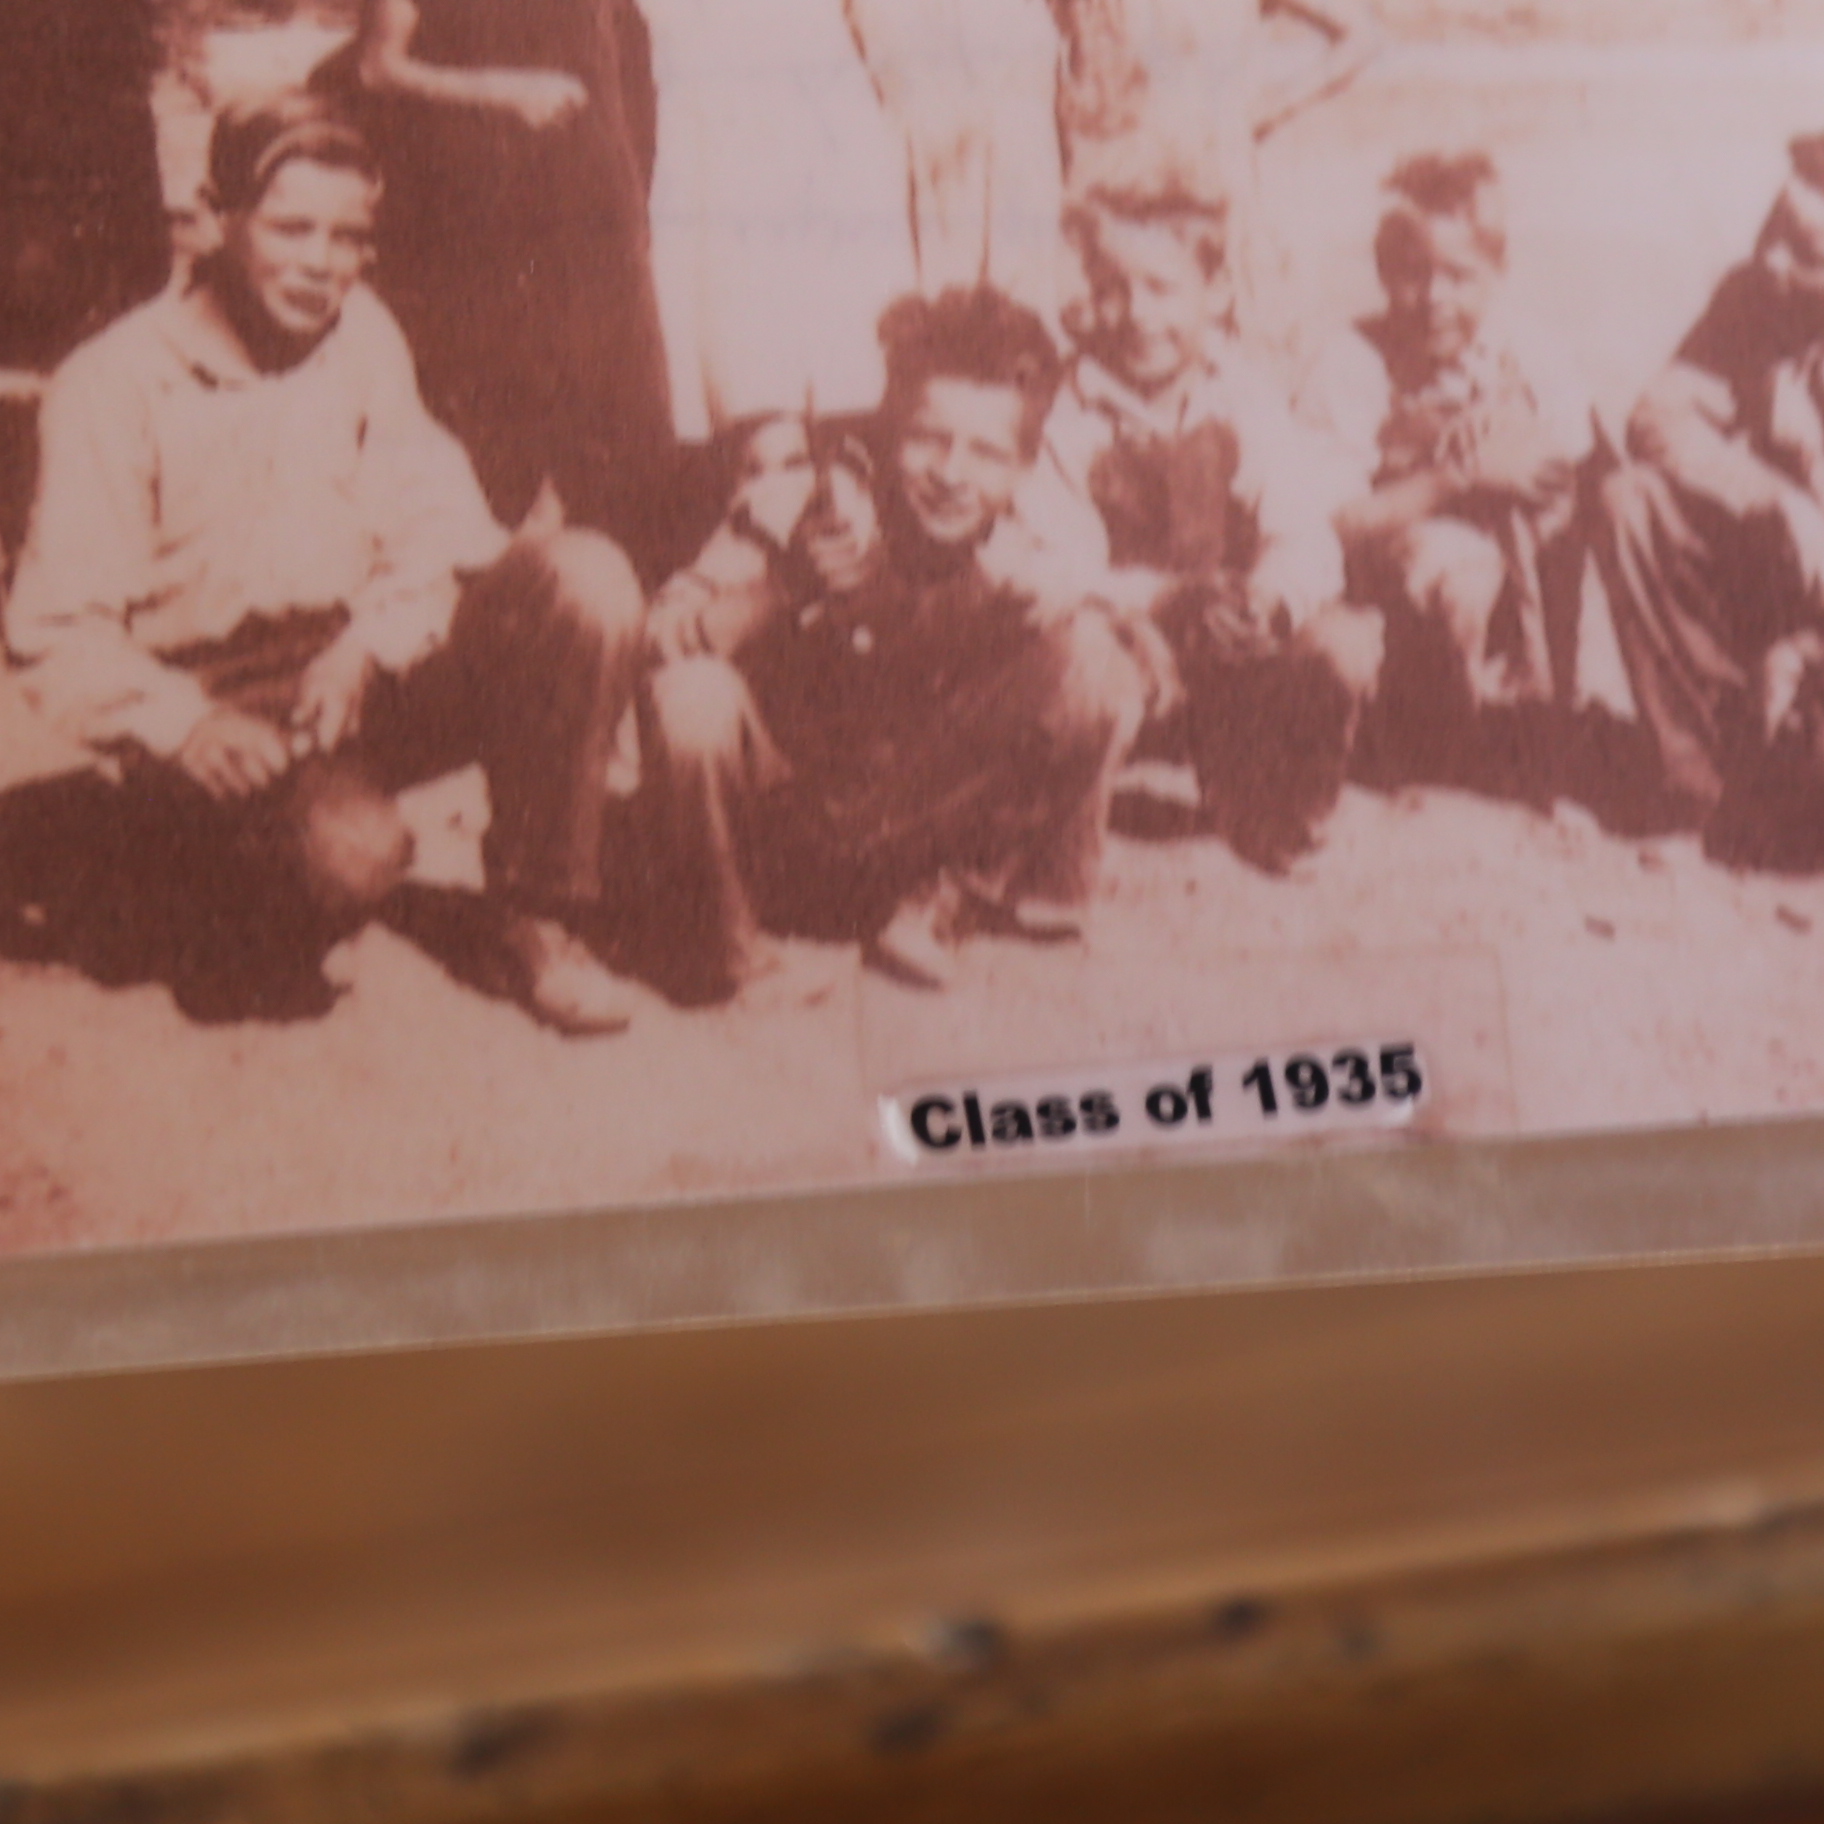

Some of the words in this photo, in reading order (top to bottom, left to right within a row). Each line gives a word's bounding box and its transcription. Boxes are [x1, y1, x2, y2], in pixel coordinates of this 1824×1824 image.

[909, 1089, 1121, 1153] Class
[1144, 1064, 1214, 1130] of
[1241, 1041, 1423, 1117] 1935
